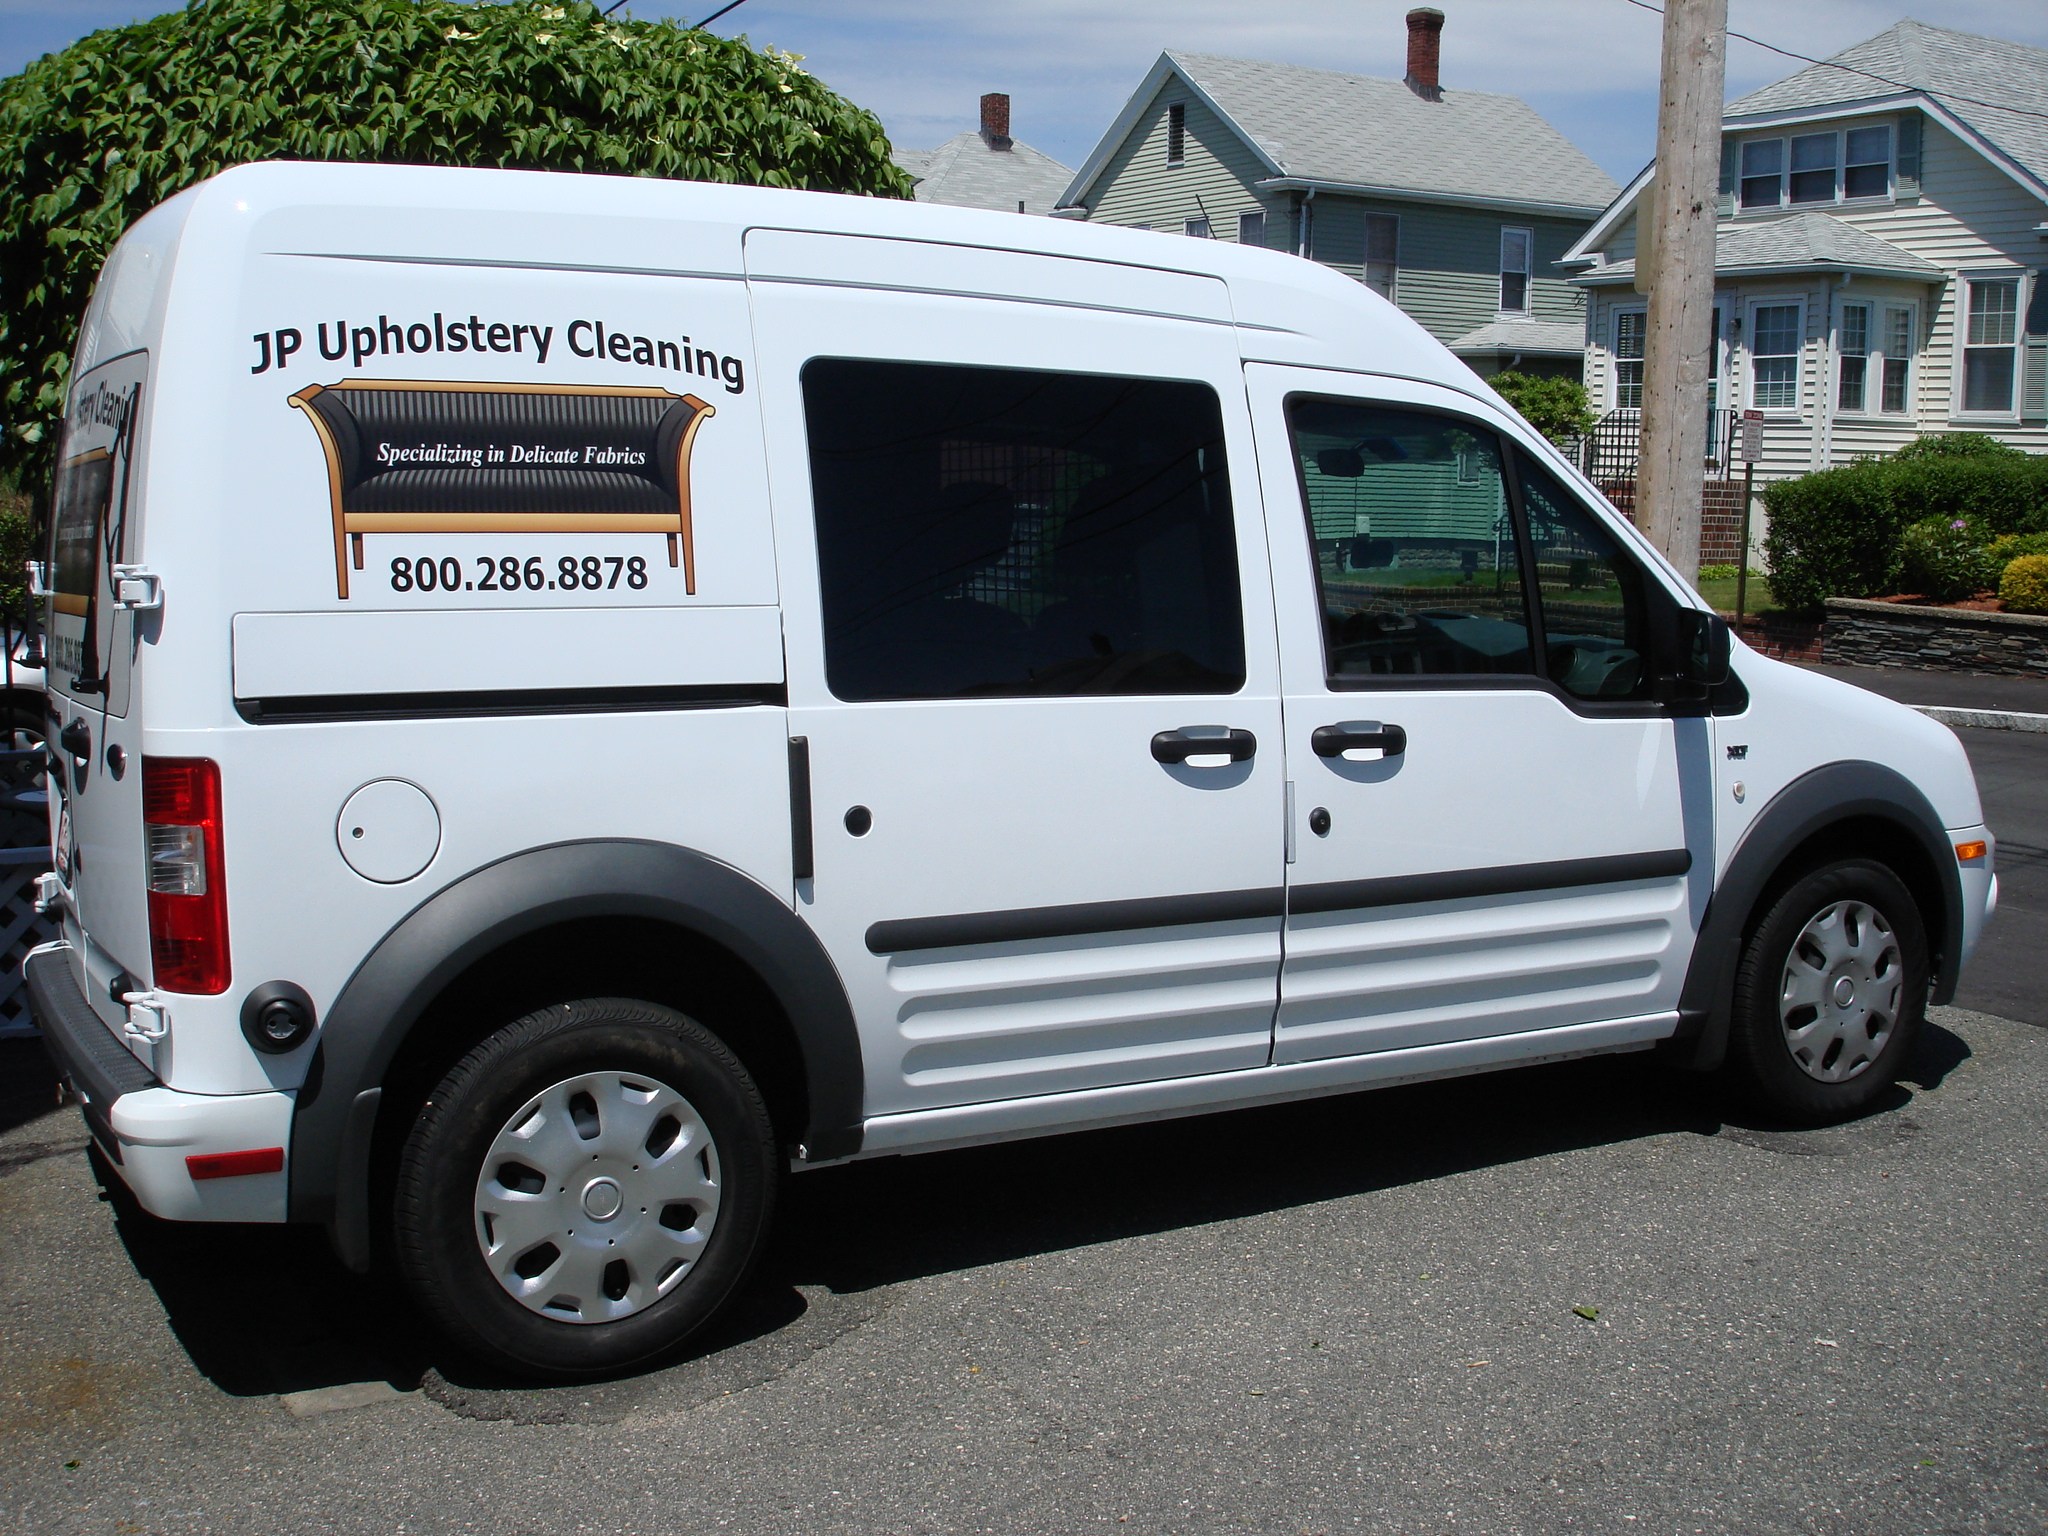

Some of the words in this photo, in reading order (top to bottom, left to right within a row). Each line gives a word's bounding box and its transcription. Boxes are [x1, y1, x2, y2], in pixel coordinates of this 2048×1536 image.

[251, 328, 302, 375] JP
[317, 312, 553, 368] Upholstery
[567, 319, 744, 395] Cleaning
[96, 380, 128, 429] Cleani
[376, 442, 484, 468] Specializing
[487, 443, 505, 463] in
[509, 444, 580, 464] Delicate
[583, 446, 646, 465] Fabrics
[390, 556, 648, 593] 800.286.8878
